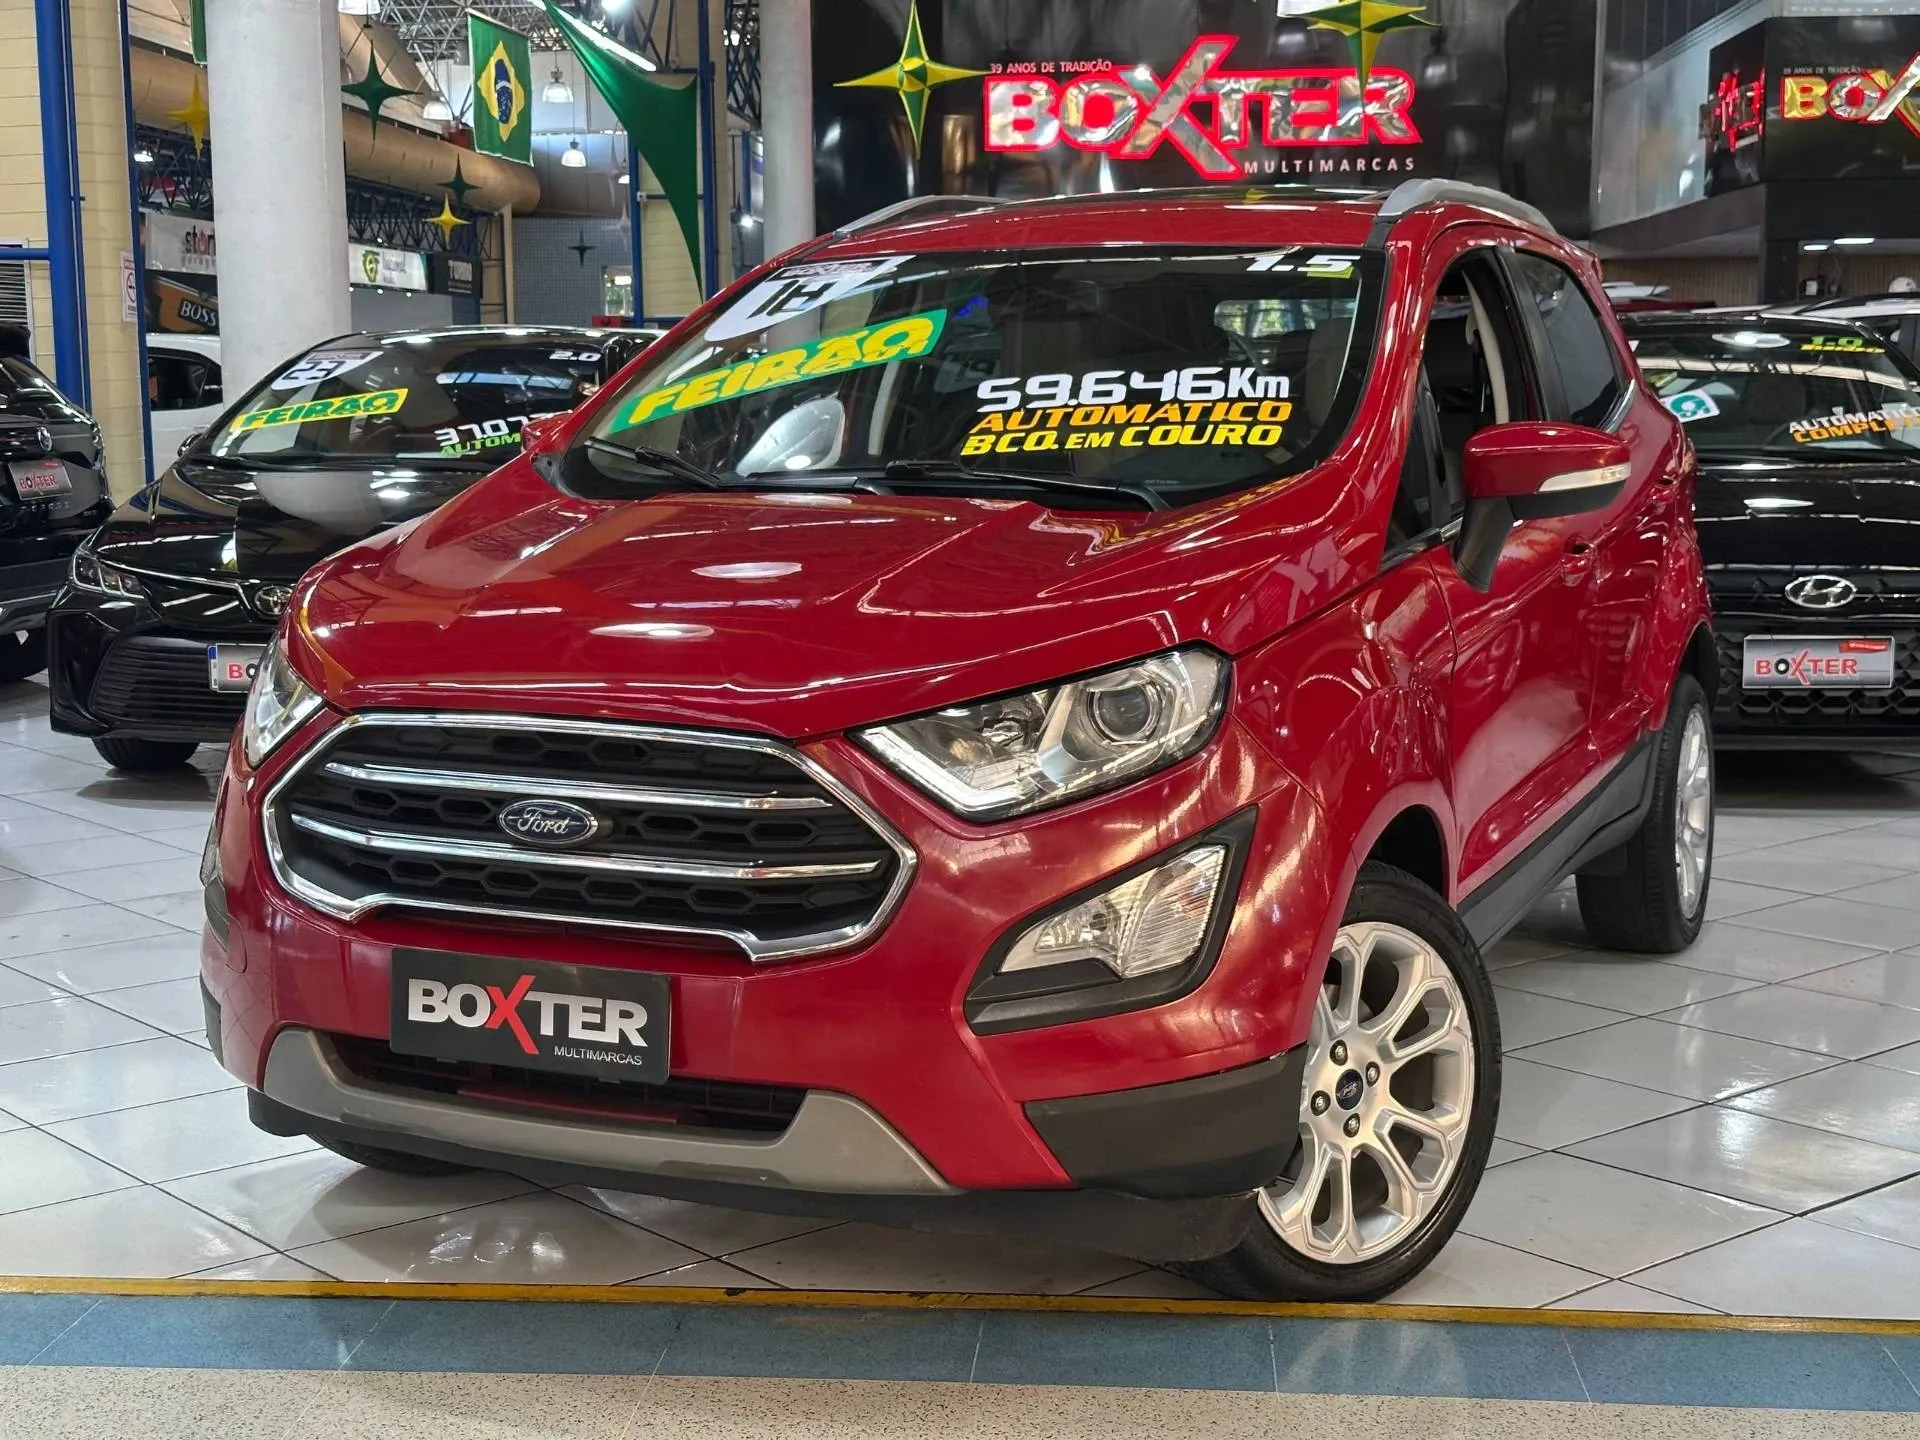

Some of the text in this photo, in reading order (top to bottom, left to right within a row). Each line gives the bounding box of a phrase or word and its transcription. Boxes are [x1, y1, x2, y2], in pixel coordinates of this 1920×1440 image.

[990, 59, 1112, 74] 39 ANOS DE TRADIÇÃO
[984, 34, 1422, 180] BOXTER
[1244, 157, 1414, 174] MULTIMARCAS
[1246, 255, 1361, 272] 1.5
[181, 301, 217, 327] BOSS
[549, 350, 601, 361] 2.0
[628, 317, 934, 425] FEIRÃO
[1065, 431, 1114, 449] EM
[1120, 424, 1283, 447] COURO
[1755, 650, 1858, 686] BOXTER
[517, 806, 570, 834] Ford
[408, 974, 648, 1055] BOXTER
[554, 1045, 643, 1066] MULTIMARCAS
